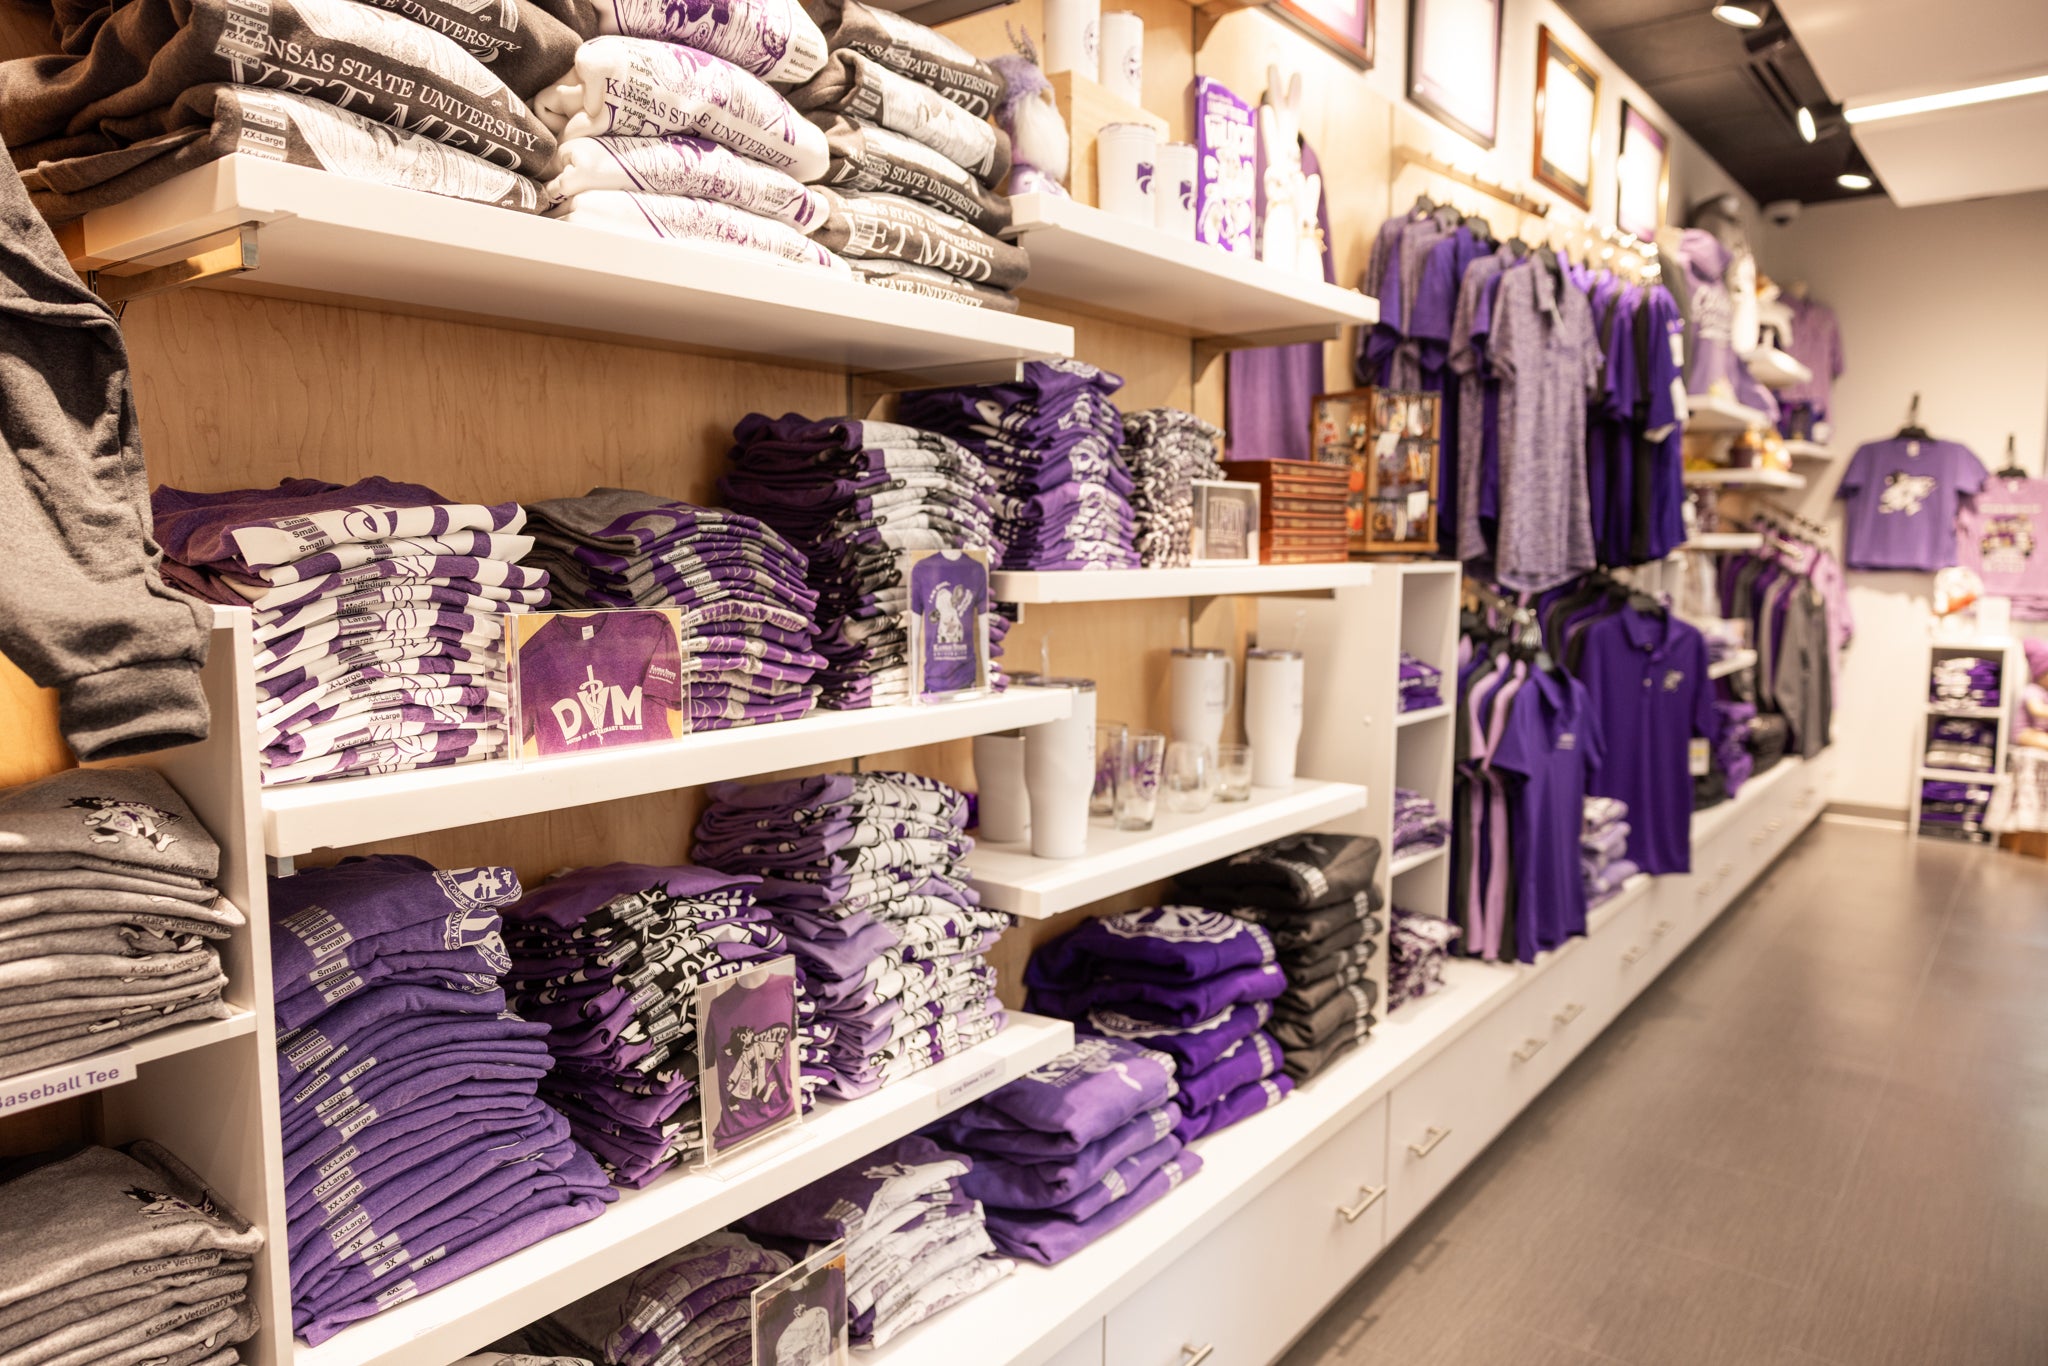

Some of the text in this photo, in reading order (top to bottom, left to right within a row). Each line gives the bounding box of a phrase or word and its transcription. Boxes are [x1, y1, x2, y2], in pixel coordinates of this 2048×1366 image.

[229, 12, 267, 32] XX-Large
[401, 0, 521, 53] UNIVERSITY
[225, 30, 264, 49] XX-Large
[630, 61, 653, 77] X-Large
[629, 76, 653, 92] X-Large
[940, 66, 999, 99] UNIVERSITY
[339, 57, 416, 98] STATE
[419, 84, 539, 152] UNIVERSITY
[626, 91, 651, 106] X-Large
[244, 111, 285, 129] XX-Large
[622, 105, 646, 119] X-Large
[617, 118, 640, 132] X-Large
[243, 129, 284, 147] XX-Large
[711, 122, 798, 168] UNIVERSITY
[890, 165, 927, 190] STATE
[928, 180, 984, 219] UNIVERSITY
[926, 219, 995, 259] UNIVERSITY
[913, 229, 992, 282] MED
[869, 277, 916, 294] STATE
[916, 282, 984, 309] UNIVERSITY
[292, 525, 319, 539] Small
[299, 539, 325, 553] Small
[345, 573, 379, 585] Medium
[687, 575, 710, 586] Medium
[345, 598, 379, 609] Medium
[346, 614, 372, 623] Large
[349, 636, 374, 646] Large
[330, 672, 361, 690] X-Large
[369, 712, 401, 722] XX-Large
[551, 685, 643, 740] DVM
[335, 736, 369, 749] XX-Large
[448, 883, 470, 907] College
[304, 918, 328, 935] Small
[312, 926, 337, 942] Small
[320, 936, 345, 953] Small
[615, 944, 633, 955] Small
[317, 961, 342, 978] Small
[639, 969, 656, 984] Small
[324, 972, 348, 989] Small
[332, 980, 356, 999] Small
[632, 985, 656, 1002] X-Large
[652, 997, 675, 1014] X-Large
[655, 1027, 680, 1041] X-Large
[754, 1027, 789, 1043] STATE
[290, 1037, 325, 1060] Medium
[298, 1046, 332, 1071] Medium
[86, 1067, 120, 1086] Tee
[346, 1061, 371, 1080] Large
[296, 1074, 329, 1101] Medium
[321, 1091, 347, 1109] Large
[330, 1105, 355, 1124] Large
[348, 1115, 372, 1133] Large
[321, 1147, 355, 1174] XX-Large
[315, 1170, 350, 1196] XX-Large
[327, 1183, 361, 1212] XX-Large
[332, 1214, 367, 1240] XX-Large
[350, 1239, 363, 1251] 3X
[373, 1241, 386, 1253] 3X
[173, 1250, 220, 1268] Veterinary
[384, 1257, 397, 1269] 3X
[422, 1255, 438, 1267] 4XL
[386, 1286, 403, 1297] 4XL
[184, 1299, 229, 1321] Veterinary
